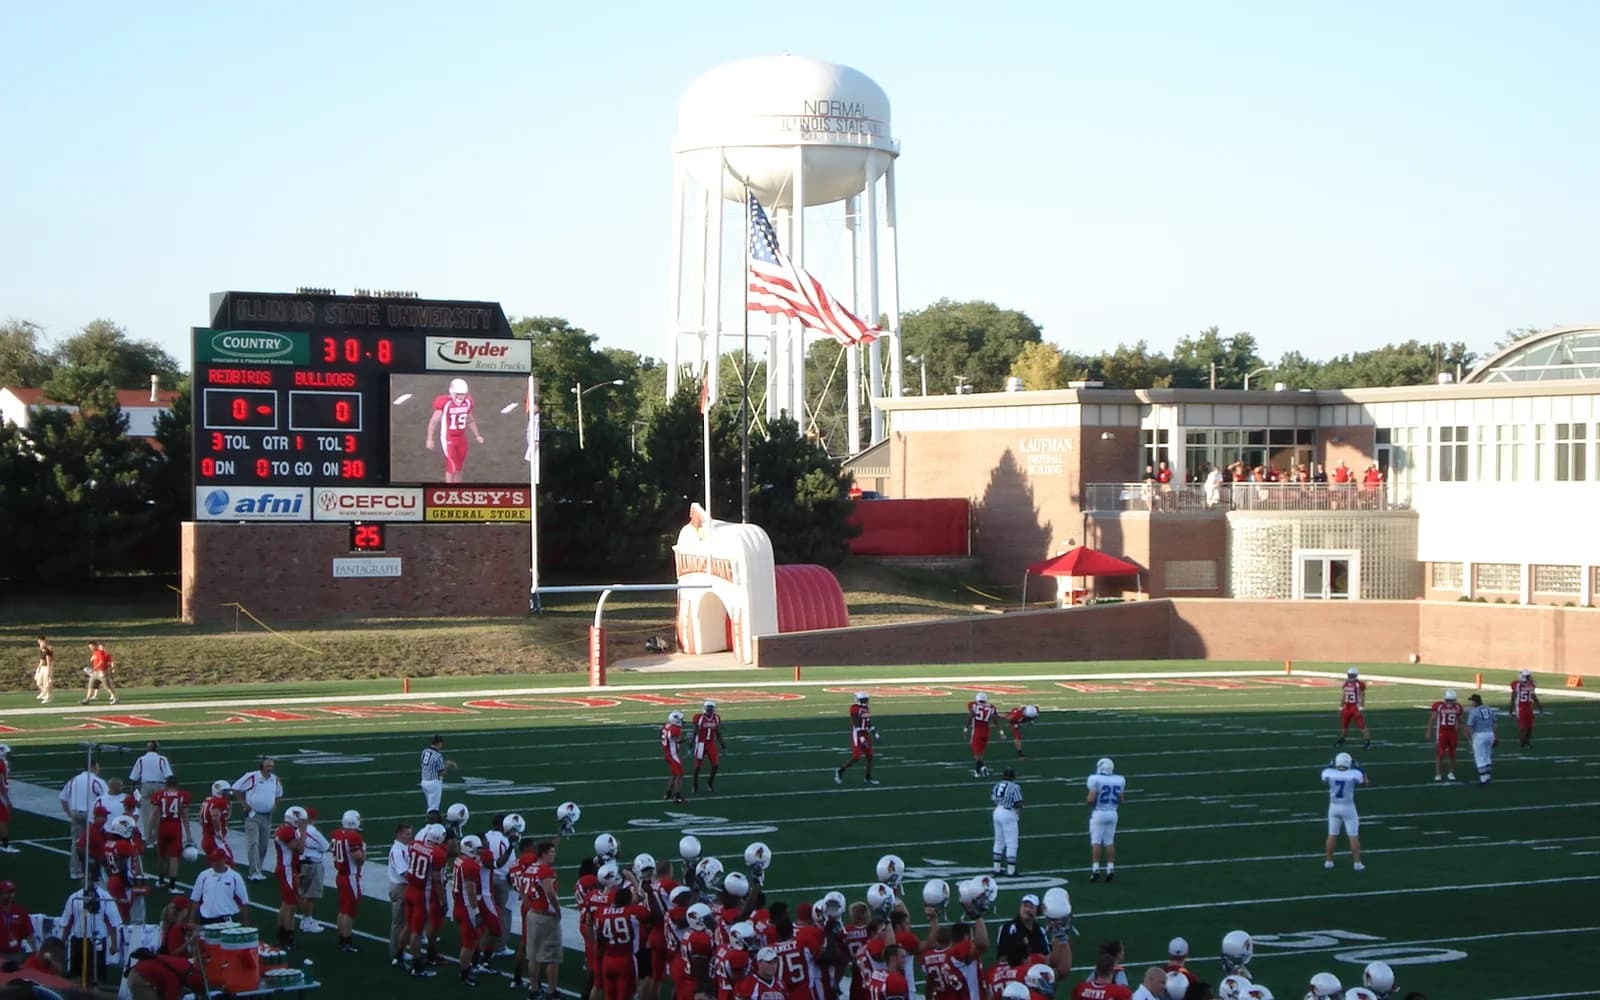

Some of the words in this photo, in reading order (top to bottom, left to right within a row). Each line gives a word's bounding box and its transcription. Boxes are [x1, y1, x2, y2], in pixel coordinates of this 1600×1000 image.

[836, 120, 865, 133] STATE
[237, 300, 315, 322] ILLINOIS
[324, 303, 381, 327] STATE
[387, 304, 494, 329] UNIVERSITY
[223, 336, 281, 349] COUNTRY
[454, 341, 509, 359] Ryder
[209, 369, 272, 385] REDBIRDS
[295, 371, 356, 387] BULLDOGS
[232, 398, 248, 420] 0
[335, 401, 350, 422] 0
[449, 413, 468, 430] 19
[212, 432, 224, 451] 3
[224, 435, 250, 450] TOL
[262, 436, 289, 450] QTR
[296, 436, 304, 450] 1
[317, 437, 342, 451] TOL
[345, 435, 357, 453] 3
[202, 458, 214, 475] 0
[216, 460, 235, 475] DN
[256, 458, 269, 476] 0
[272, 461, 290, 475] TO
[295, 461, 313, 476] GO
[323, 461, 339, 477] ON
[342, 459, 366, 477] 30
[235, 493, 304, 514] afni
[339, 494, 416, 509] CEFCU
[433, 491, 524, 505] CASEY'S
[433, 510, 484, 519] GENERAL
[490, 510, 525, 519] STORE
[354, 525, 382, 548] 25
[336, 564, 398, 575] PANTAGRAPH
[975, 706, 990, 721] 57
[1440, 713, 1456, 726] 19
[1100, 785, 1121, 804] 25
[1334, 781, 1346, 799] 7
[160, 798, 179, 819] 14
[408, 852, 428, 879] 10
[602, 916, 631, 945] 49
